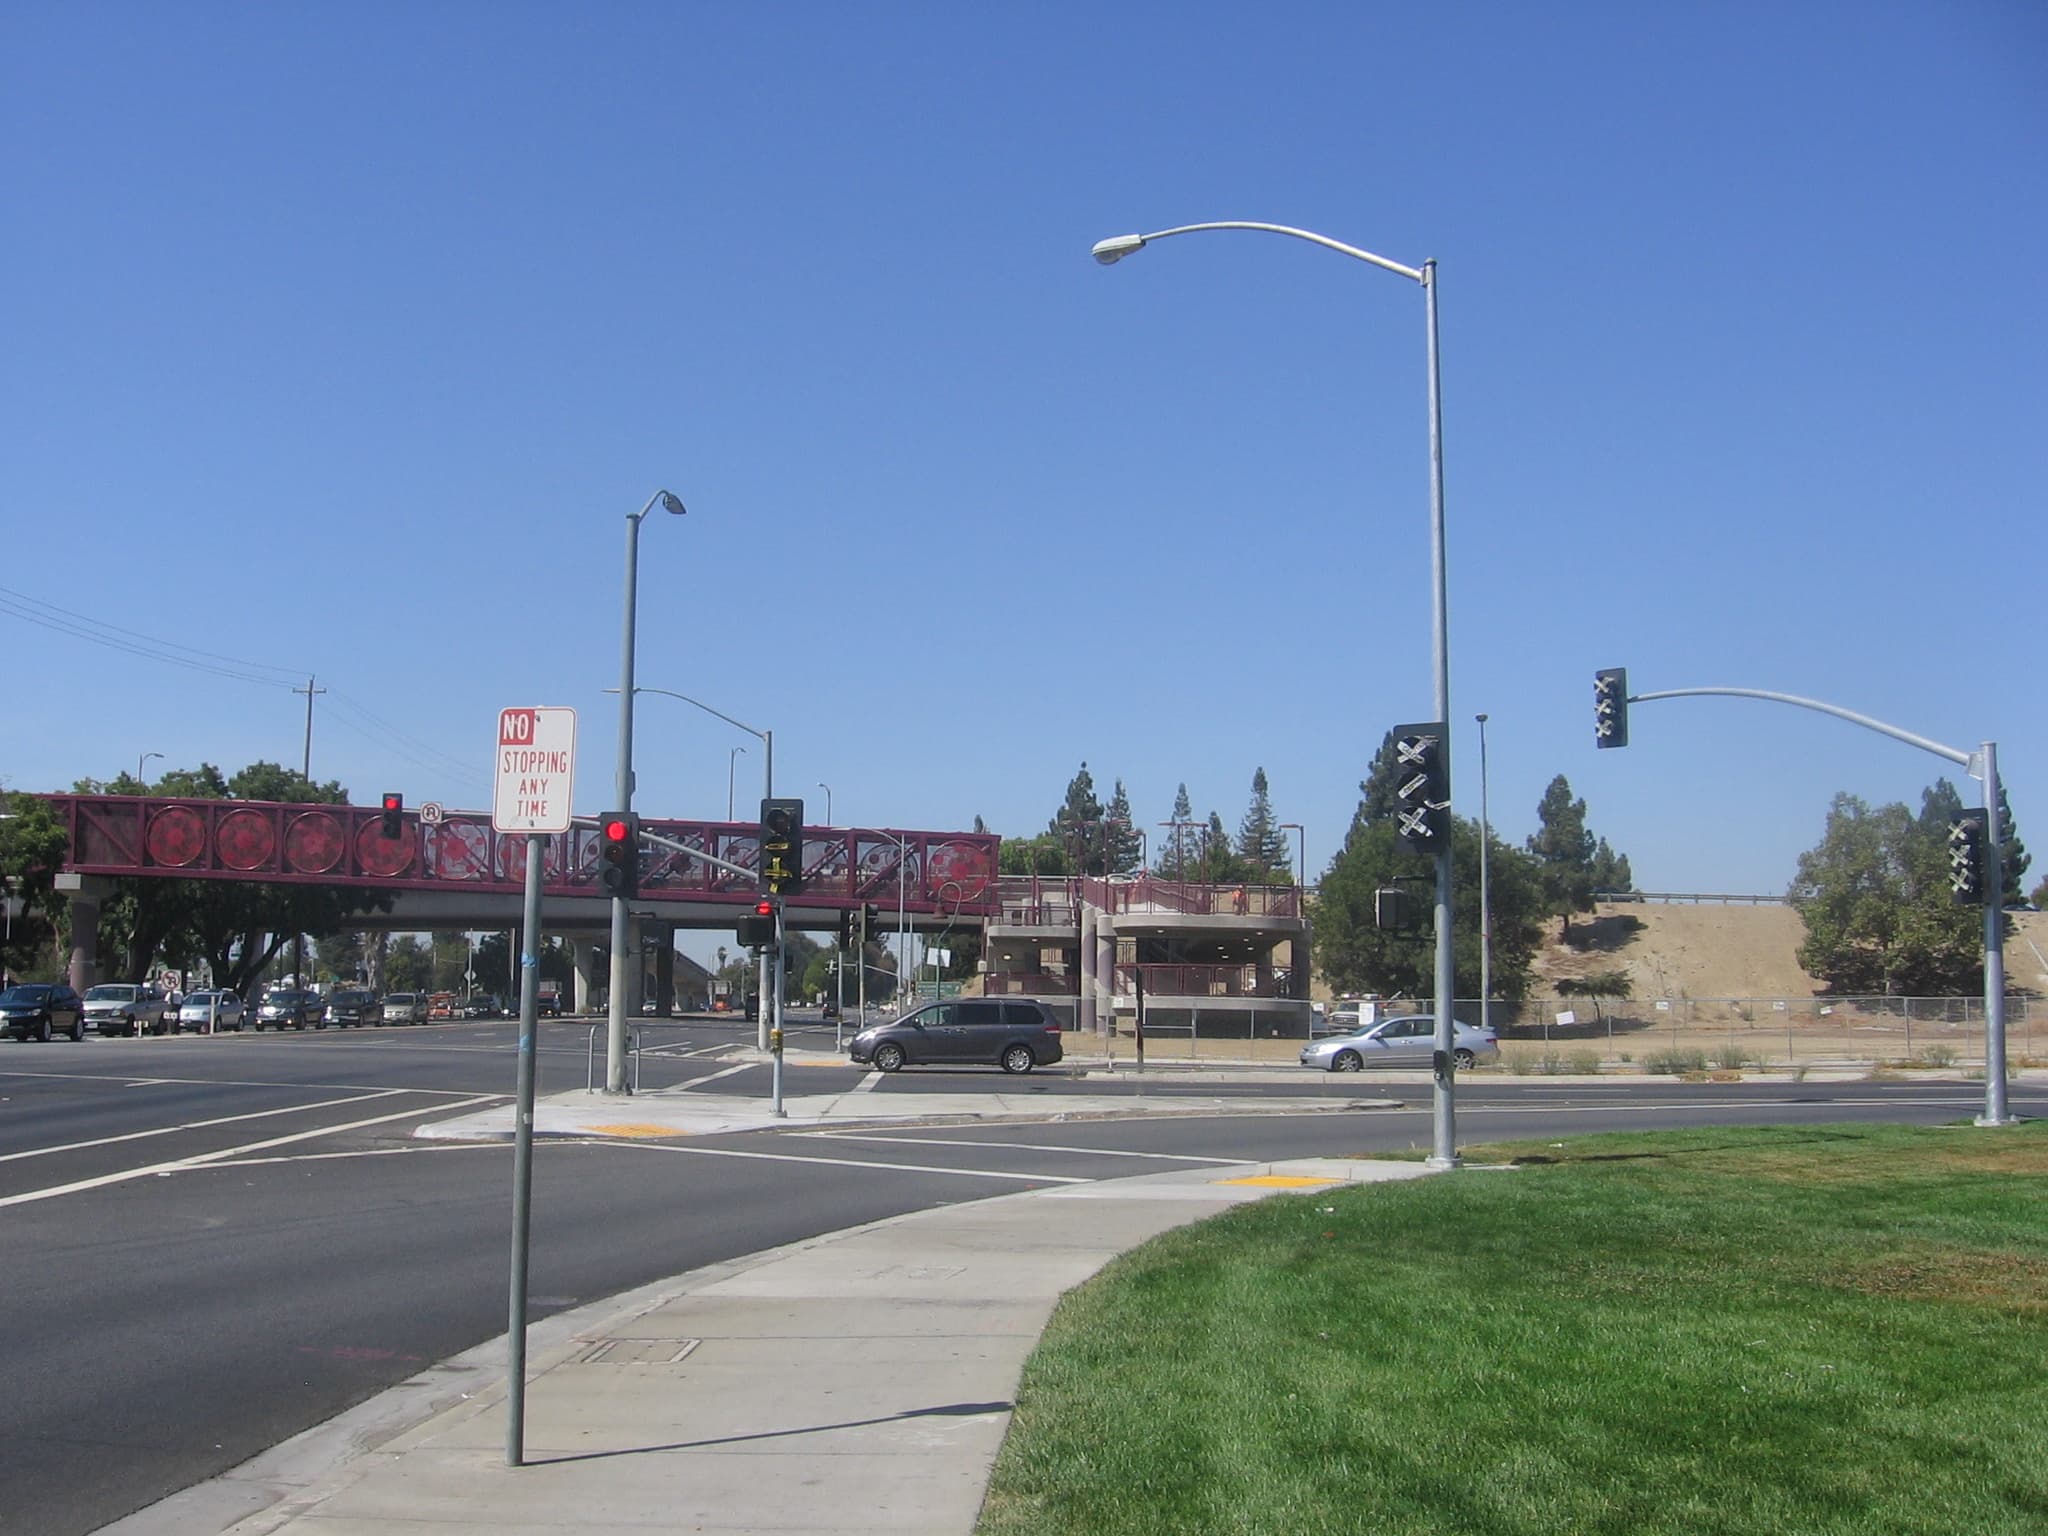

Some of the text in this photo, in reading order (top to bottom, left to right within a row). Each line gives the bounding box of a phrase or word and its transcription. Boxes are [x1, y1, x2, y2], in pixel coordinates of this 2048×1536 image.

[503, 713, 529, 740] NO
[503, 751, 567, 773] STOPPING
[519, 778, 548, 795] ANY
[517, 800, 548, 817] TIME
